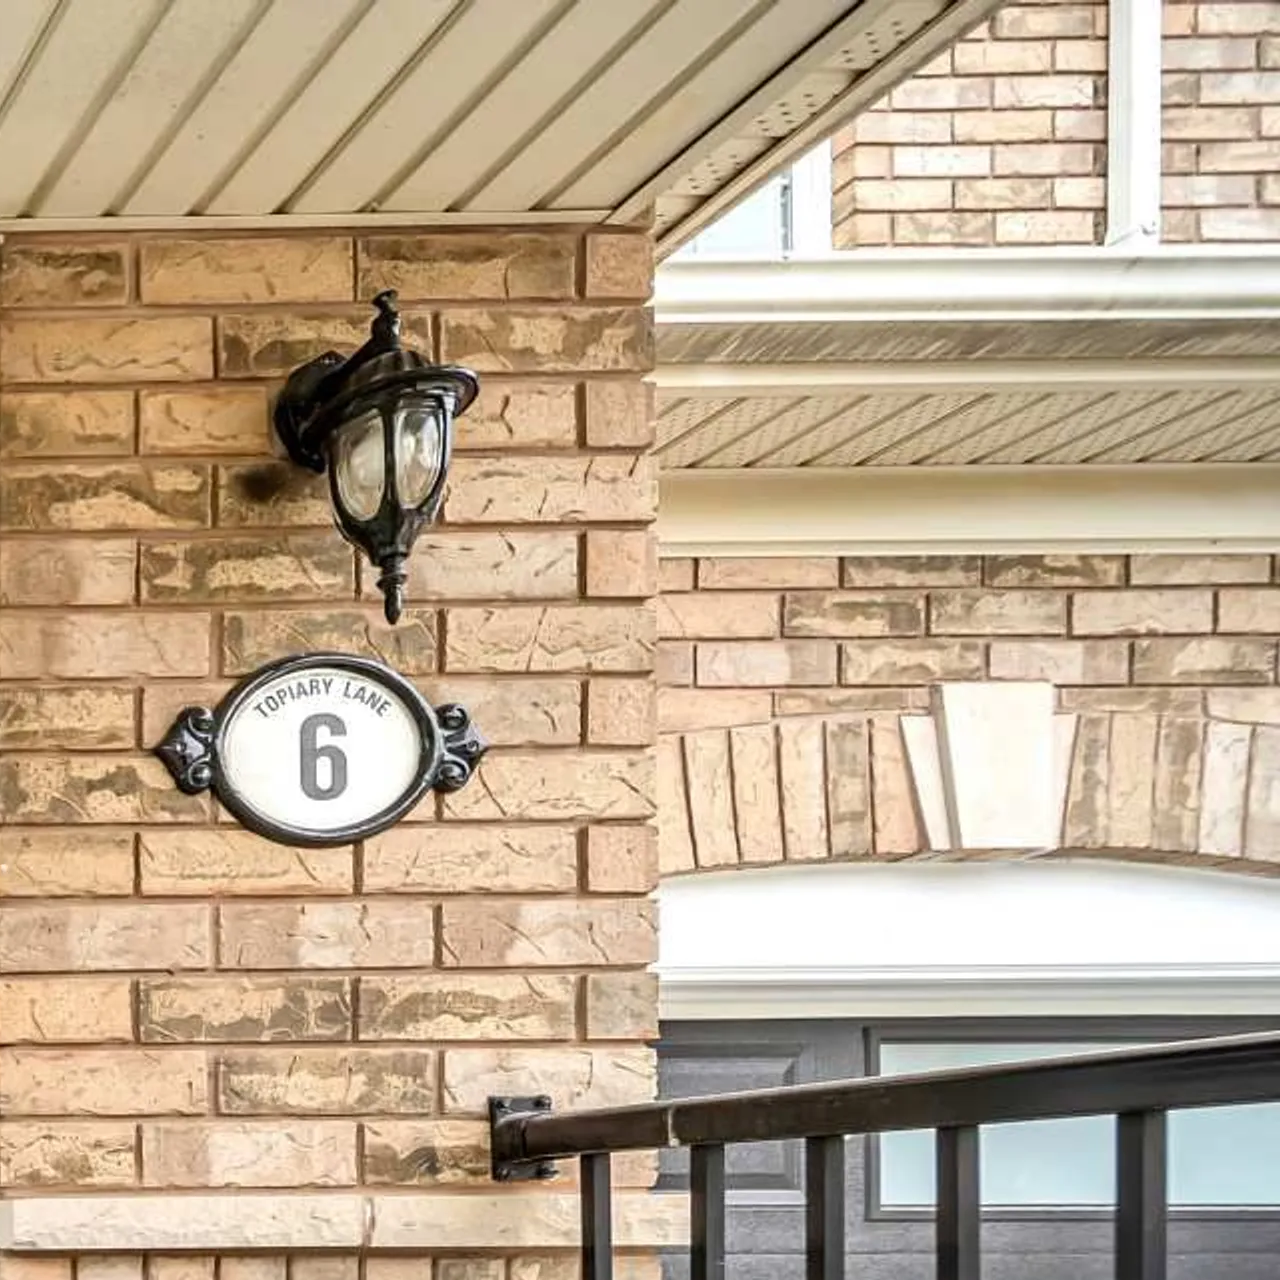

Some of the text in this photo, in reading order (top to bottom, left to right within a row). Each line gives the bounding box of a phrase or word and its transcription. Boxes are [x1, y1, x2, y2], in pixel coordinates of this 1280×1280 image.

[253, 677, 392, 718] TOPIARY LANE
[299, 712, 348, 801] 6
